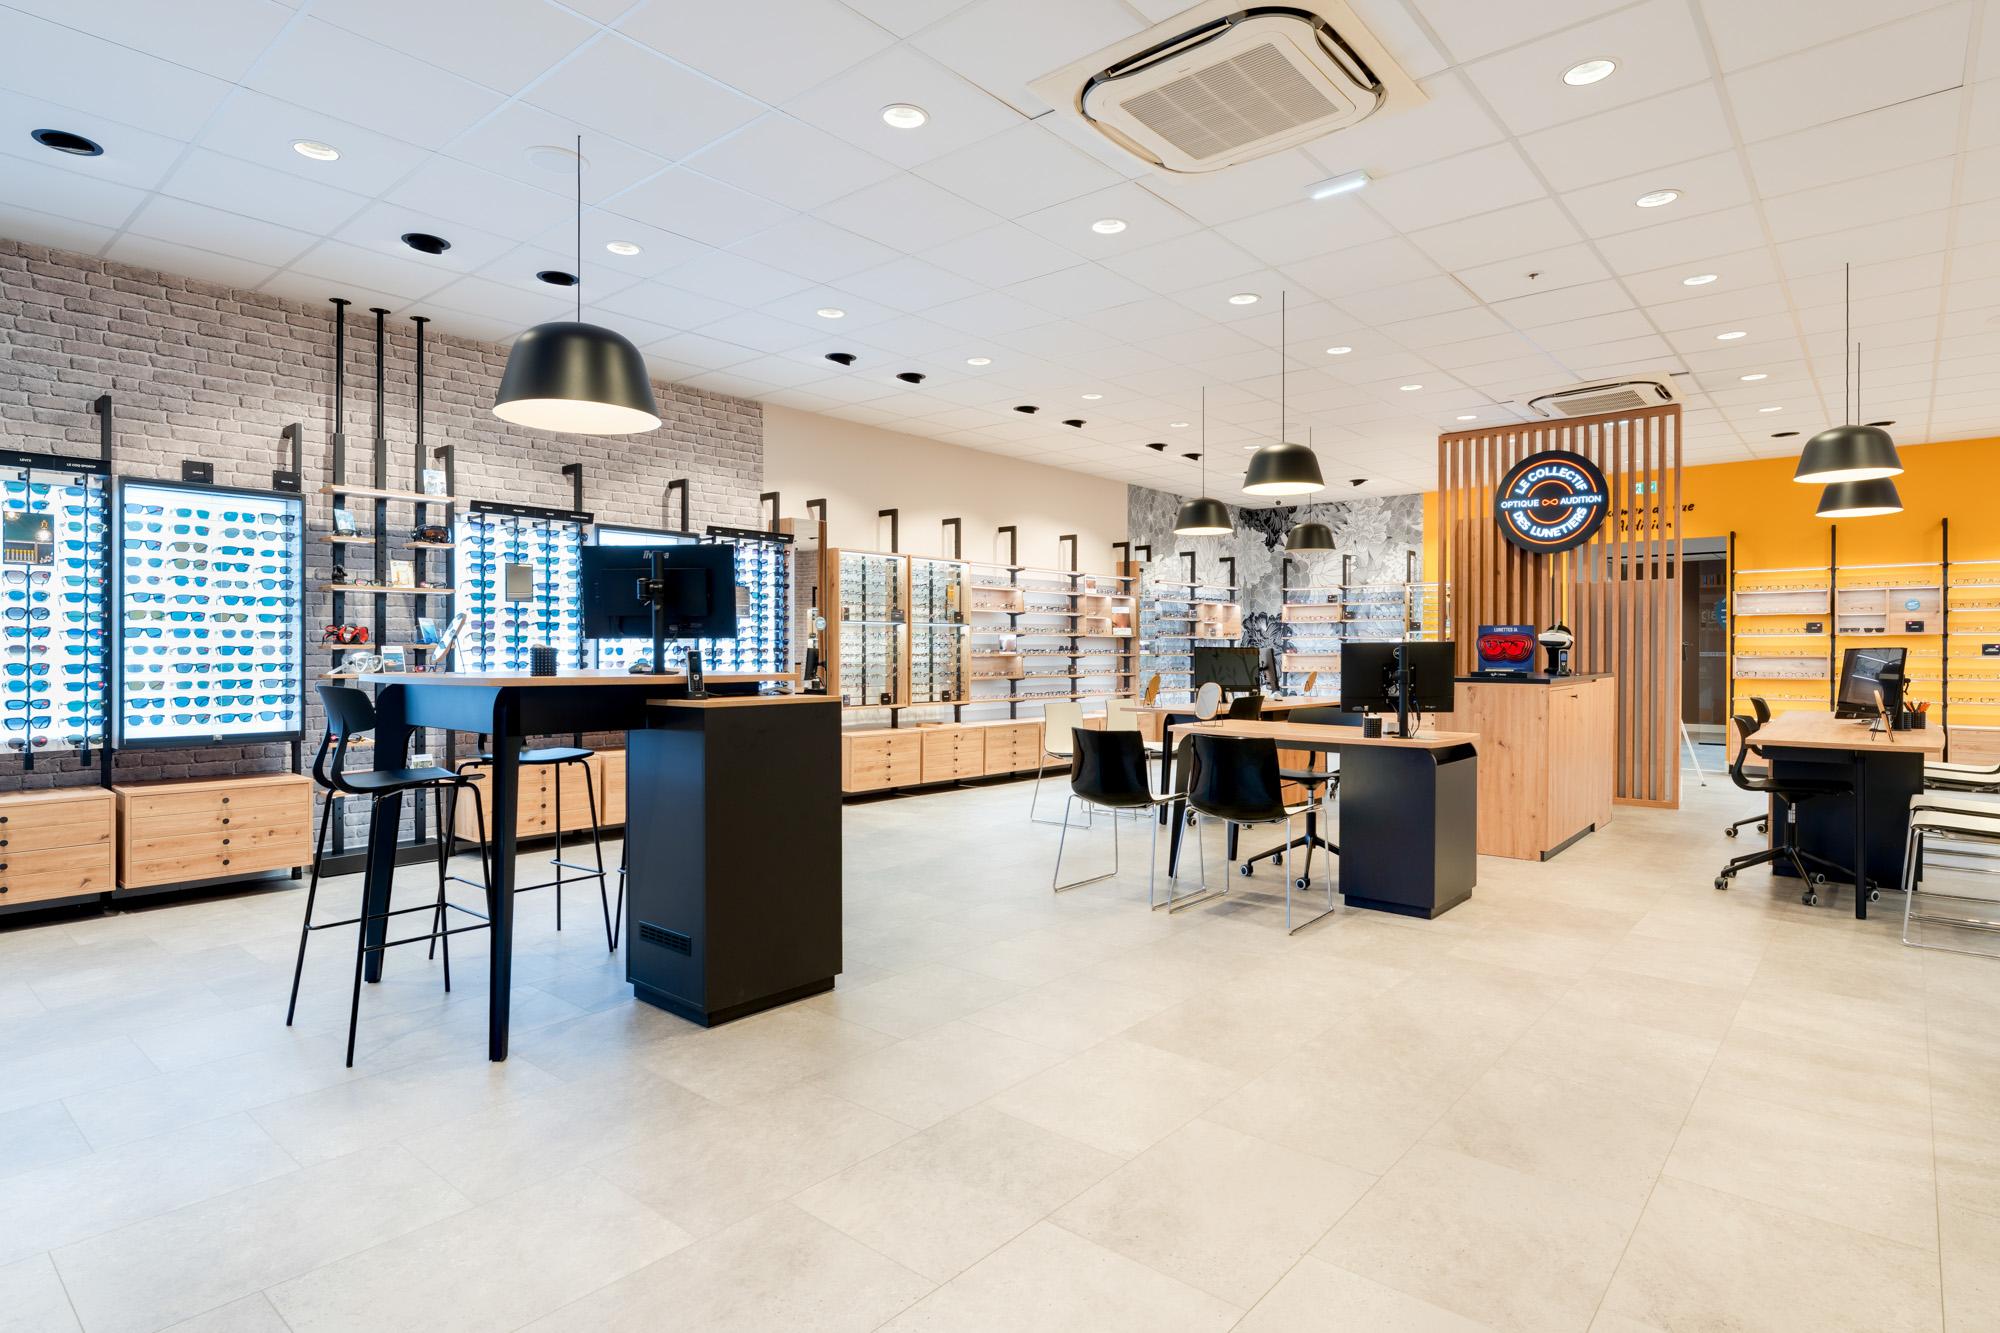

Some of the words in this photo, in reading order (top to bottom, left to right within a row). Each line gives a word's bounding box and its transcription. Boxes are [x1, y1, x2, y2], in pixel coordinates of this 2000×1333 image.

[1515, 479, 1531, 495] LE
[1528, 466, 1588, 491] COLLECTIF
[1501, 499, 1540, 509] OPTIQUE
[1560, 495, 1602, 505] AUDITION
[1513, 510, 1531, 531] DES
[1530, 507, 1588, 538] LUNETIERS
